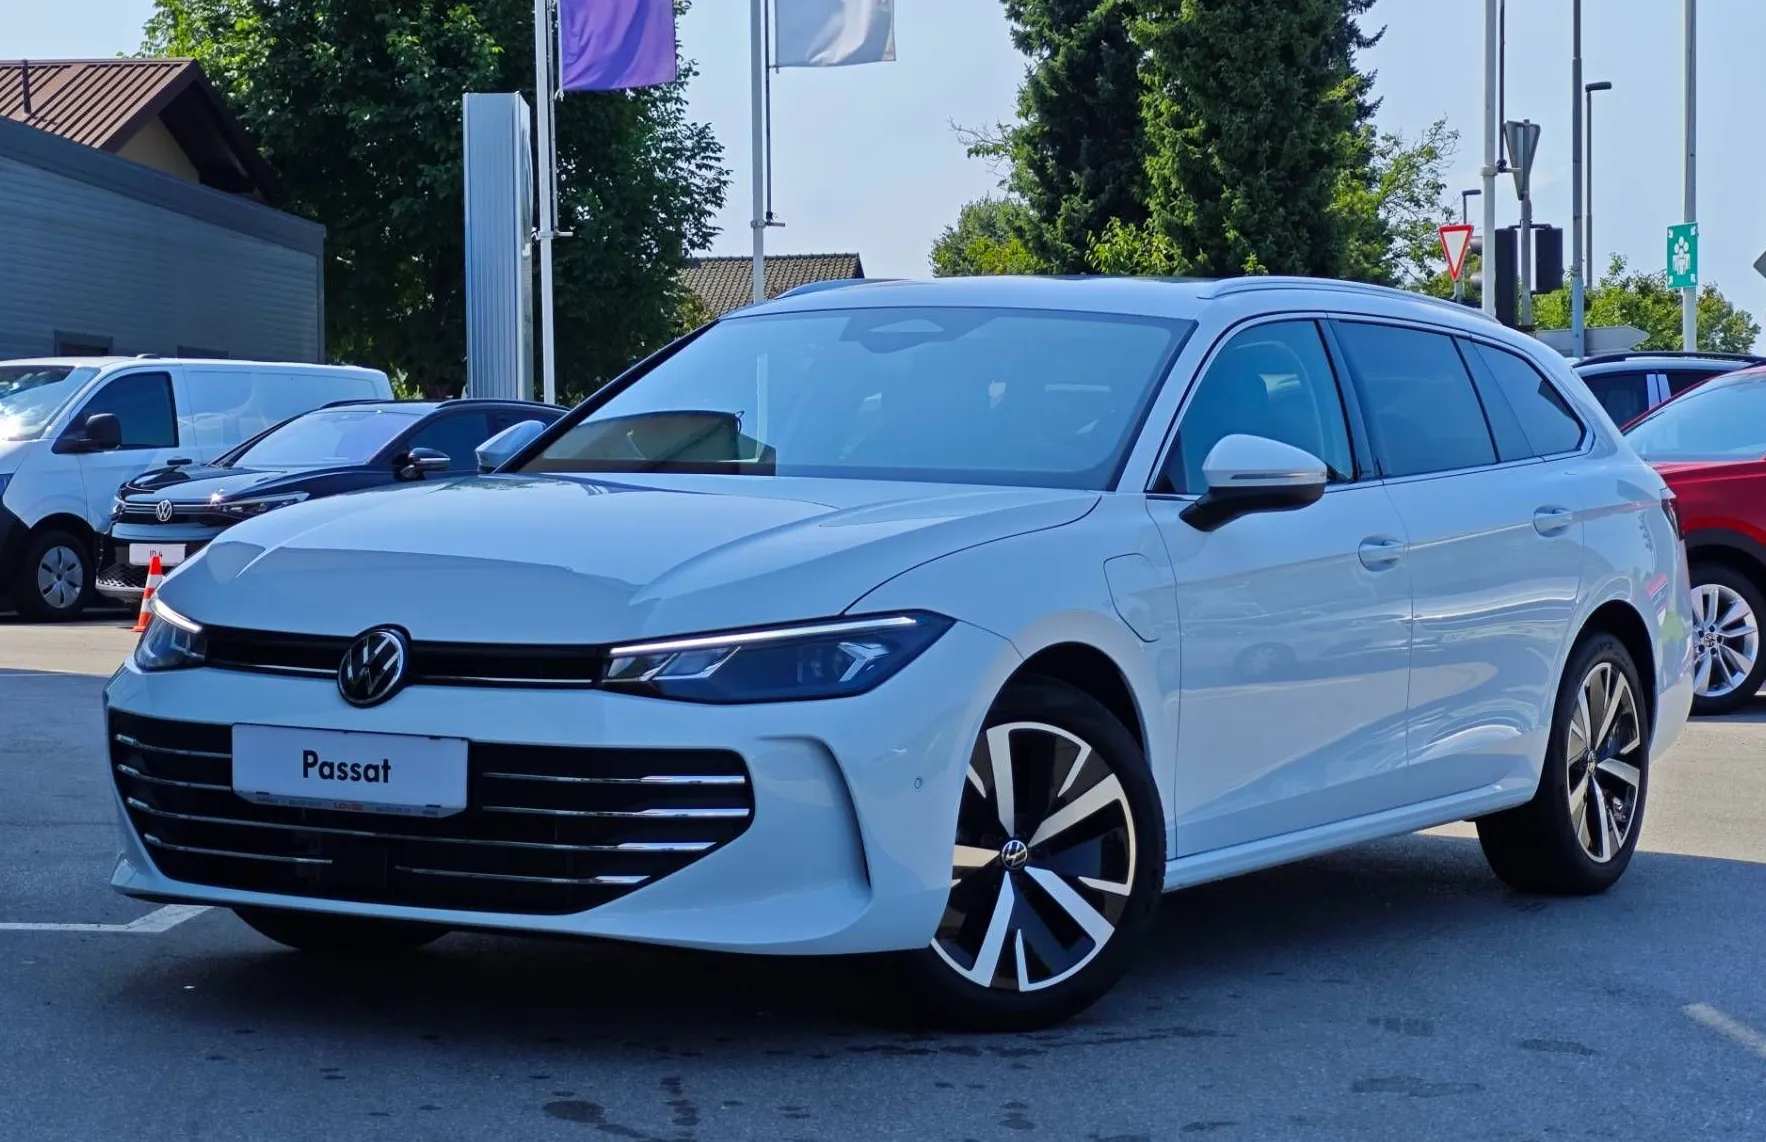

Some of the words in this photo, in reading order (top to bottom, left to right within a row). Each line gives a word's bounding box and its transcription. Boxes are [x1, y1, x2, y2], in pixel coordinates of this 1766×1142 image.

[156, 499, 173, 522] VW
[338, 631, 404, 705] VW
[302, 749, 392, 784] Passat
